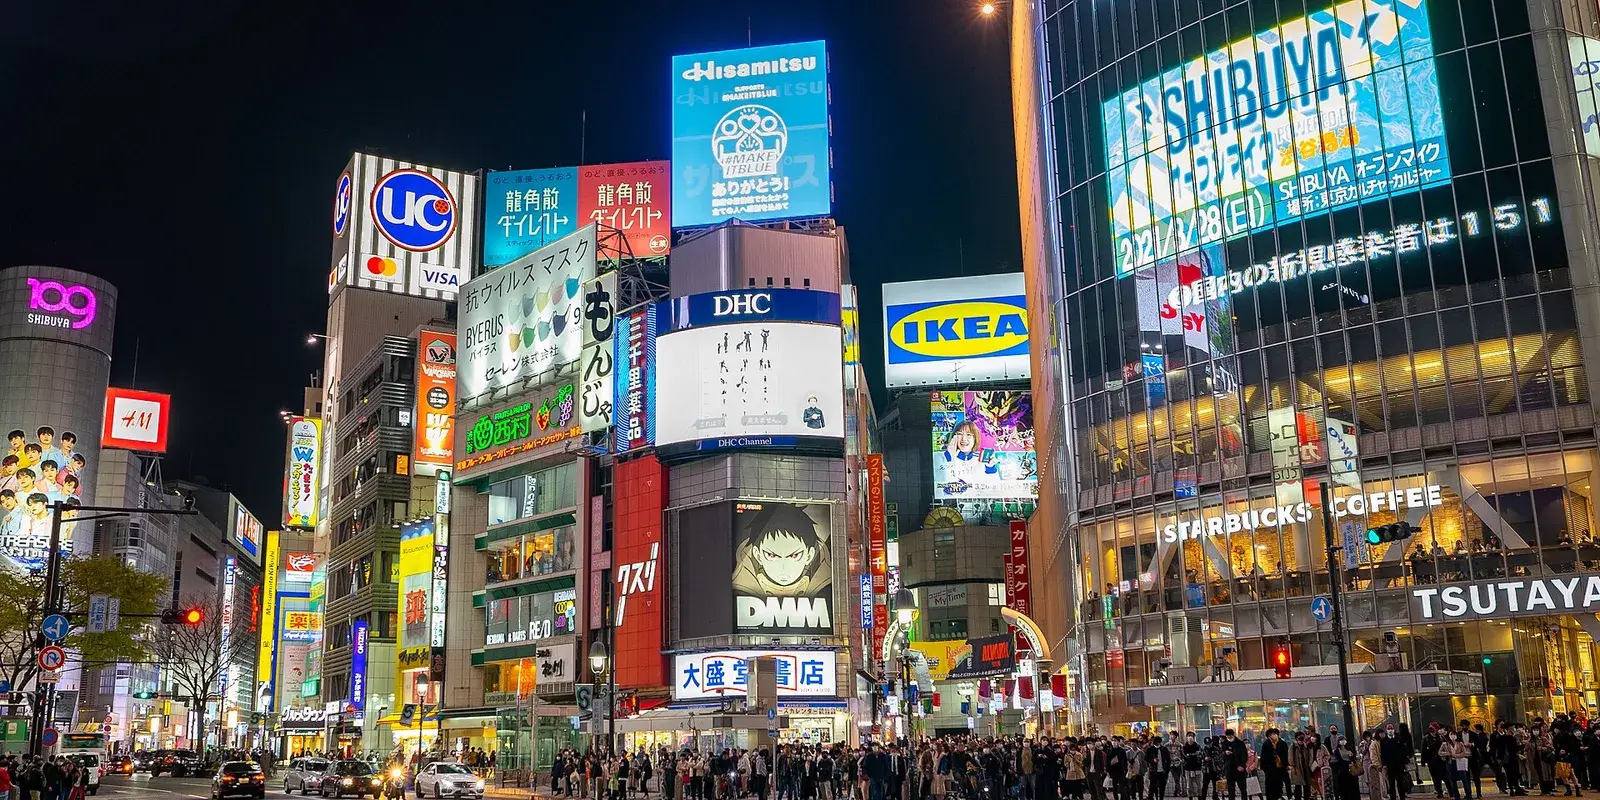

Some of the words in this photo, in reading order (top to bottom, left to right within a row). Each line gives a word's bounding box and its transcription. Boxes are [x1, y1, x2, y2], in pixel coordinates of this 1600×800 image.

[682, 56, 816, 81] Hisamitsu
[1165, 27, 1345, 155] SHIBUYA
[726, 163, 772, 175] ITBLUE
[1279, 165, 1350, 200] SHIBUYA
[382, 187, 447, 232] UC
[505, 187, 560, 213] 龍角散
[597, 181, 652, 207] 龍角散
[541, 238, 589, 276] マスク
[423, 269, 458, 287] VISA
[27, 277, 97, 329] 109
[713, 293, 771, 316] DHC
[27, 313, 70, 328] SHIBUYA
[466, 313, 504, 350] BYERUS
[904, 313, 1028, 344] IKEA
[583, 281, 613, 423] もんじゃ
[493, 413, 531, 446] 西村
[718, 437, 737, 447] DHC
[738, 437, 772, 446] Channel
[1164, 502, 1314, 543] STARBUCKS
[1329, 485, 1442, 517] COFFEE
[1012, 529, 1027, 592] カラオケ
[737, 596, 831, 628] DMM
[1413, 576, 1600, 619] TSUTAYA
[289, 612, 308, 629] 薬
[357, 627, 366, 655] MIZUHO
